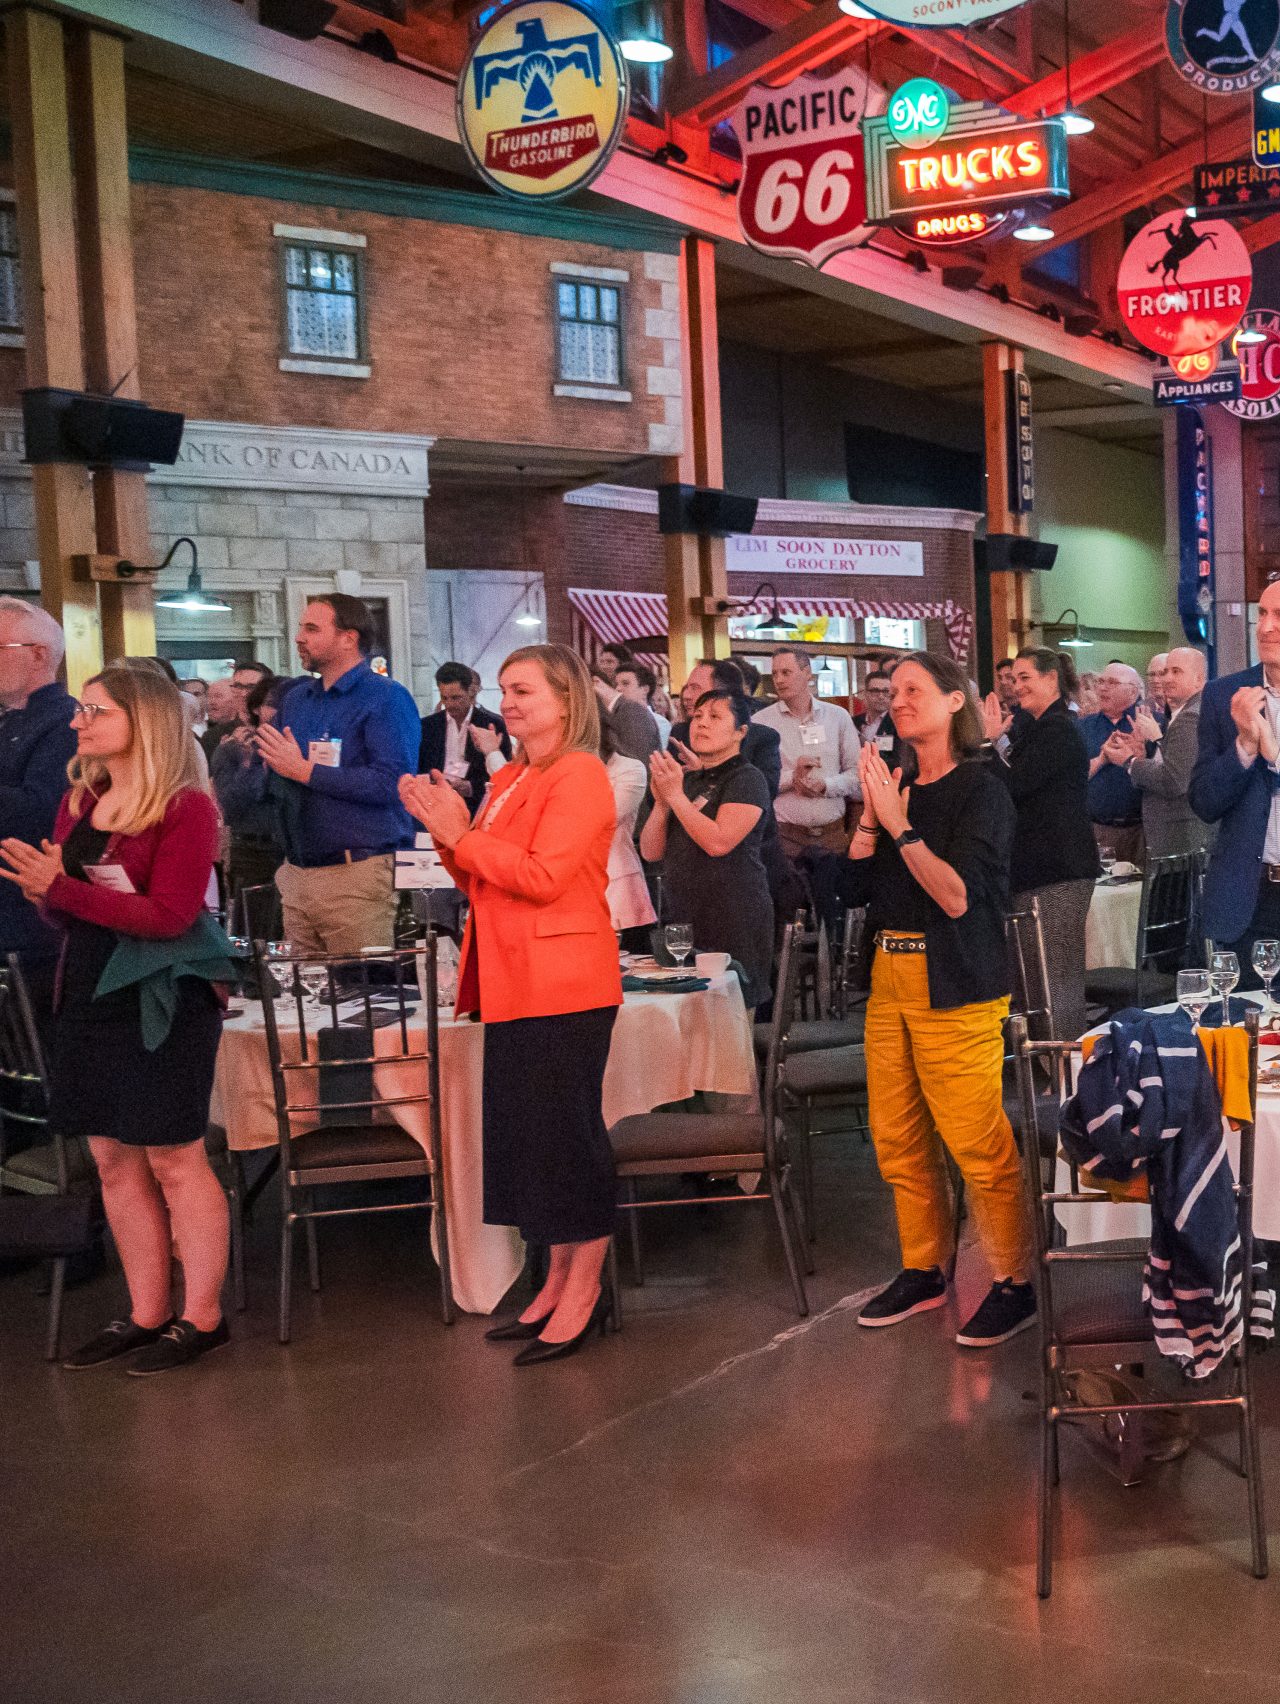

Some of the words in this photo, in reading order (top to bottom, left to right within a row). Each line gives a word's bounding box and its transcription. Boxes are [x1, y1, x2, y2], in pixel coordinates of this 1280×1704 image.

[745, 86, 857, 142] PACIFIC
[892, 93, 941, 131] GMC
[490, 122, 595, 159] THUNDERBIRD
[509, 144, 575, 168] GASOLINE
[898, 141, 1042, 193] TRUCKS
[754, 150, 854, 234] 66
[916, 213, 987, 239] DRUGS
[1127, 284, 1242, 318] FRONTIER
[1157, 380, 1234, 399] APPLIANCES
[241, 446, 282, 469] OF
[291, 449, 411, 476] CANADA
[735, 538, 768, 553] LIM
[776, 540, 825, 555] SOON
[833, 542, 902, 557] DAYTON
[786, 558, 858, 571] GROCERY
